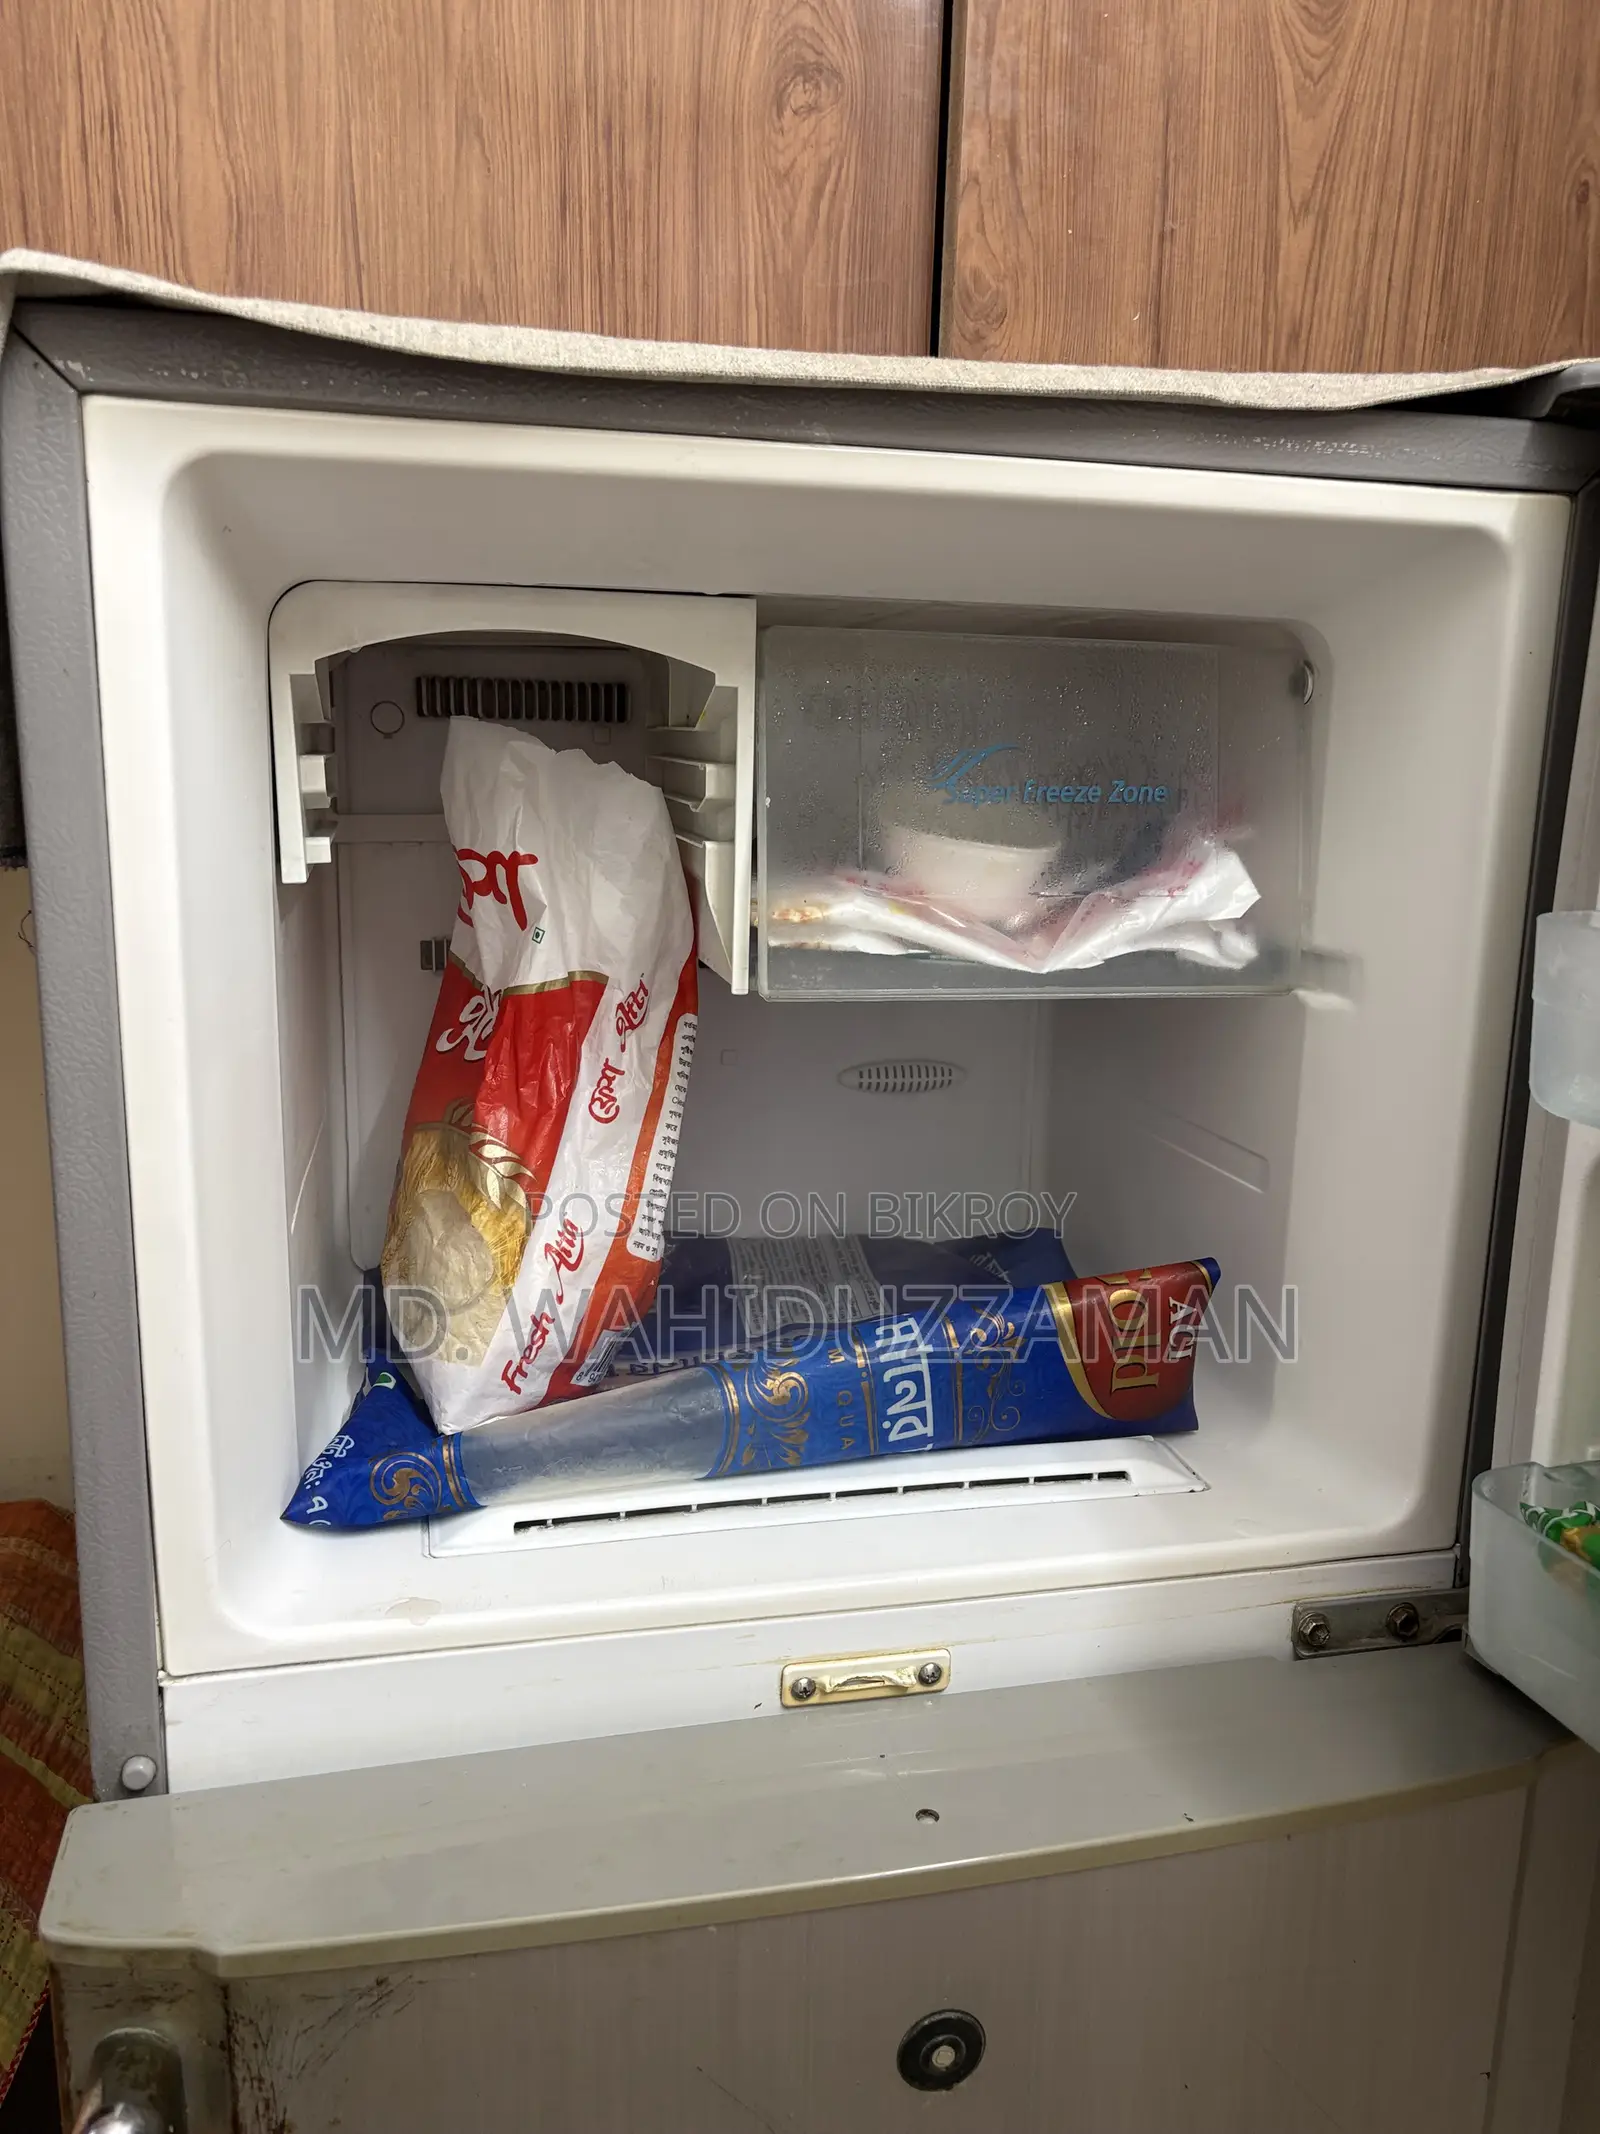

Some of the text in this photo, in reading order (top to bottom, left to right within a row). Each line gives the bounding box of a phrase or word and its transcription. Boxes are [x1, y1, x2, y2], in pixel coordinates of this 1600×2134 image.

[1023, 779, 1102, 804] Freeze
[1107, 779, 1171, 804] Zone
[500, 1219, 585, 1395] Fresh Atta
[1168, 1297, 1197, 1361] ACI
